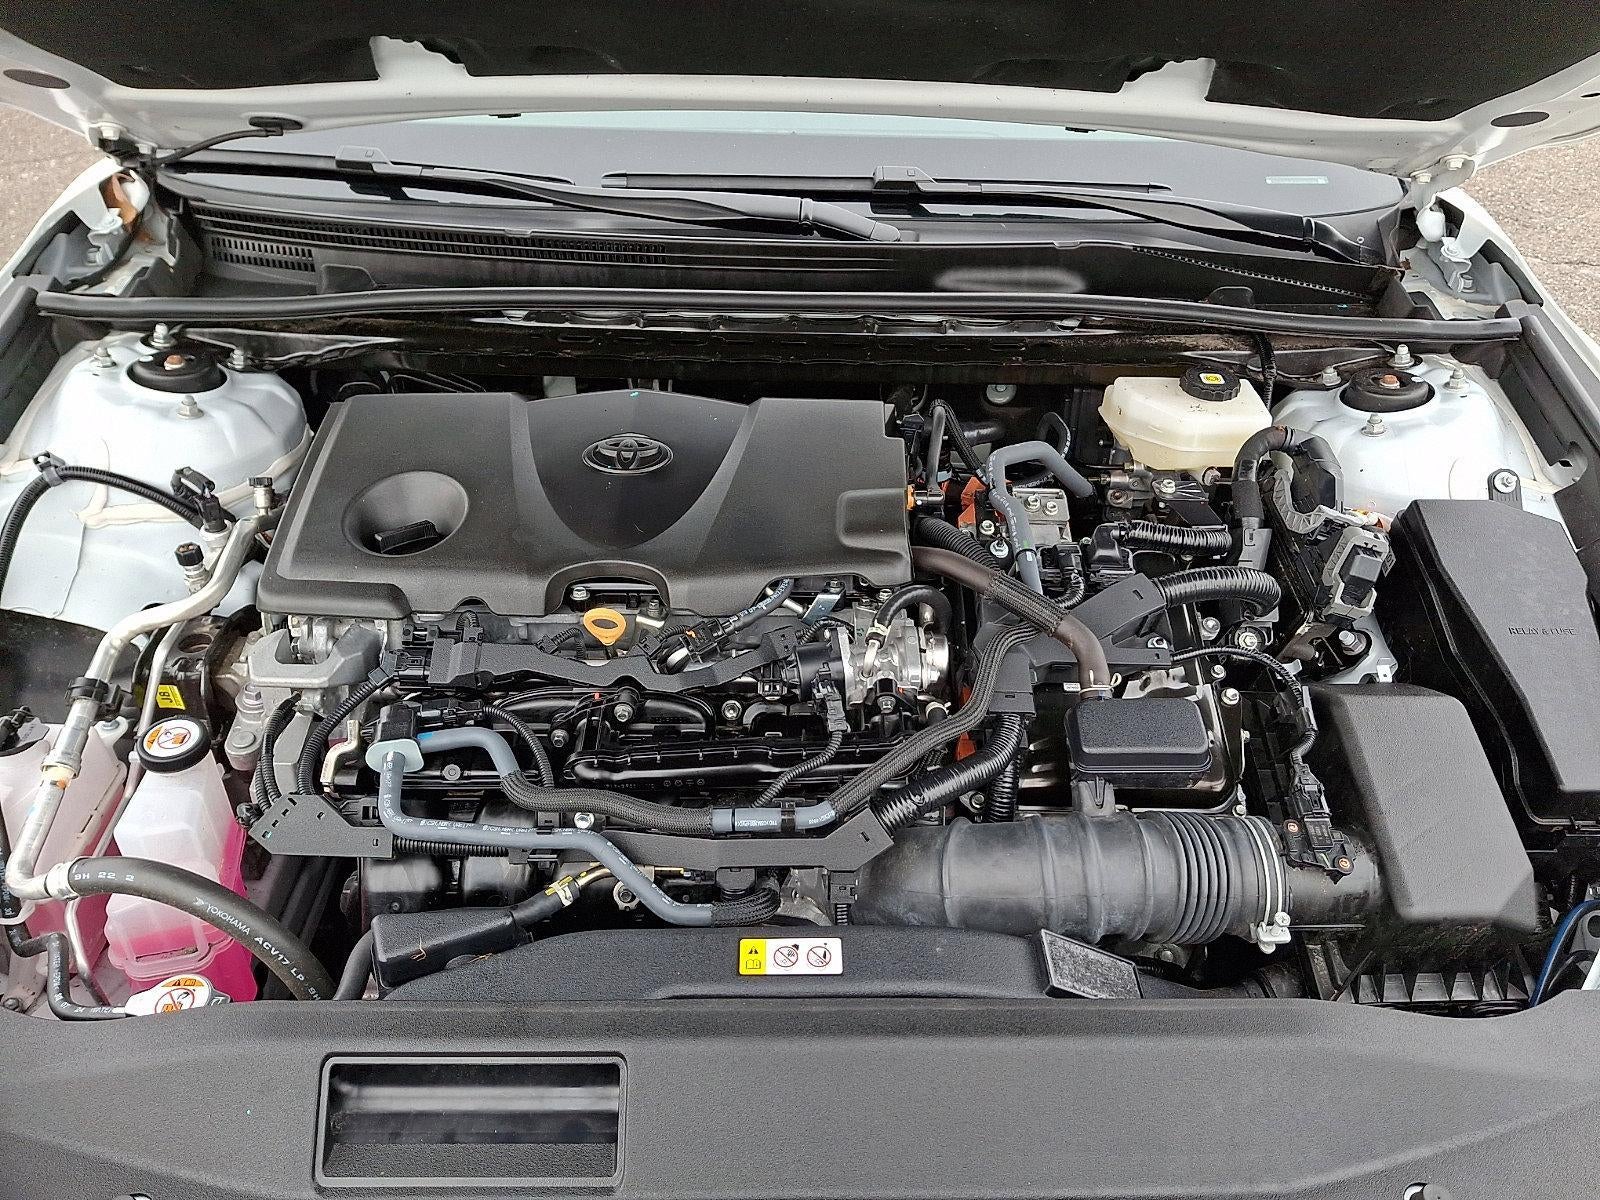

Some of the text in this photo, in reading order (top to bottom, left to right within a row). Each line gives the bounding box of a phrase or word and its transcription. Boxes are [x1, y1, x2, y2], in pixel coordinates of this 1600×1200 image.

[1508, 627, 1539, 635] RELAY
[97, 871, 116, 879] 22
[207, 904, 251, 935] YOKOHAMA
[254, 936, 291, 966] ACV17
[290, 967, 305, 982] LP
